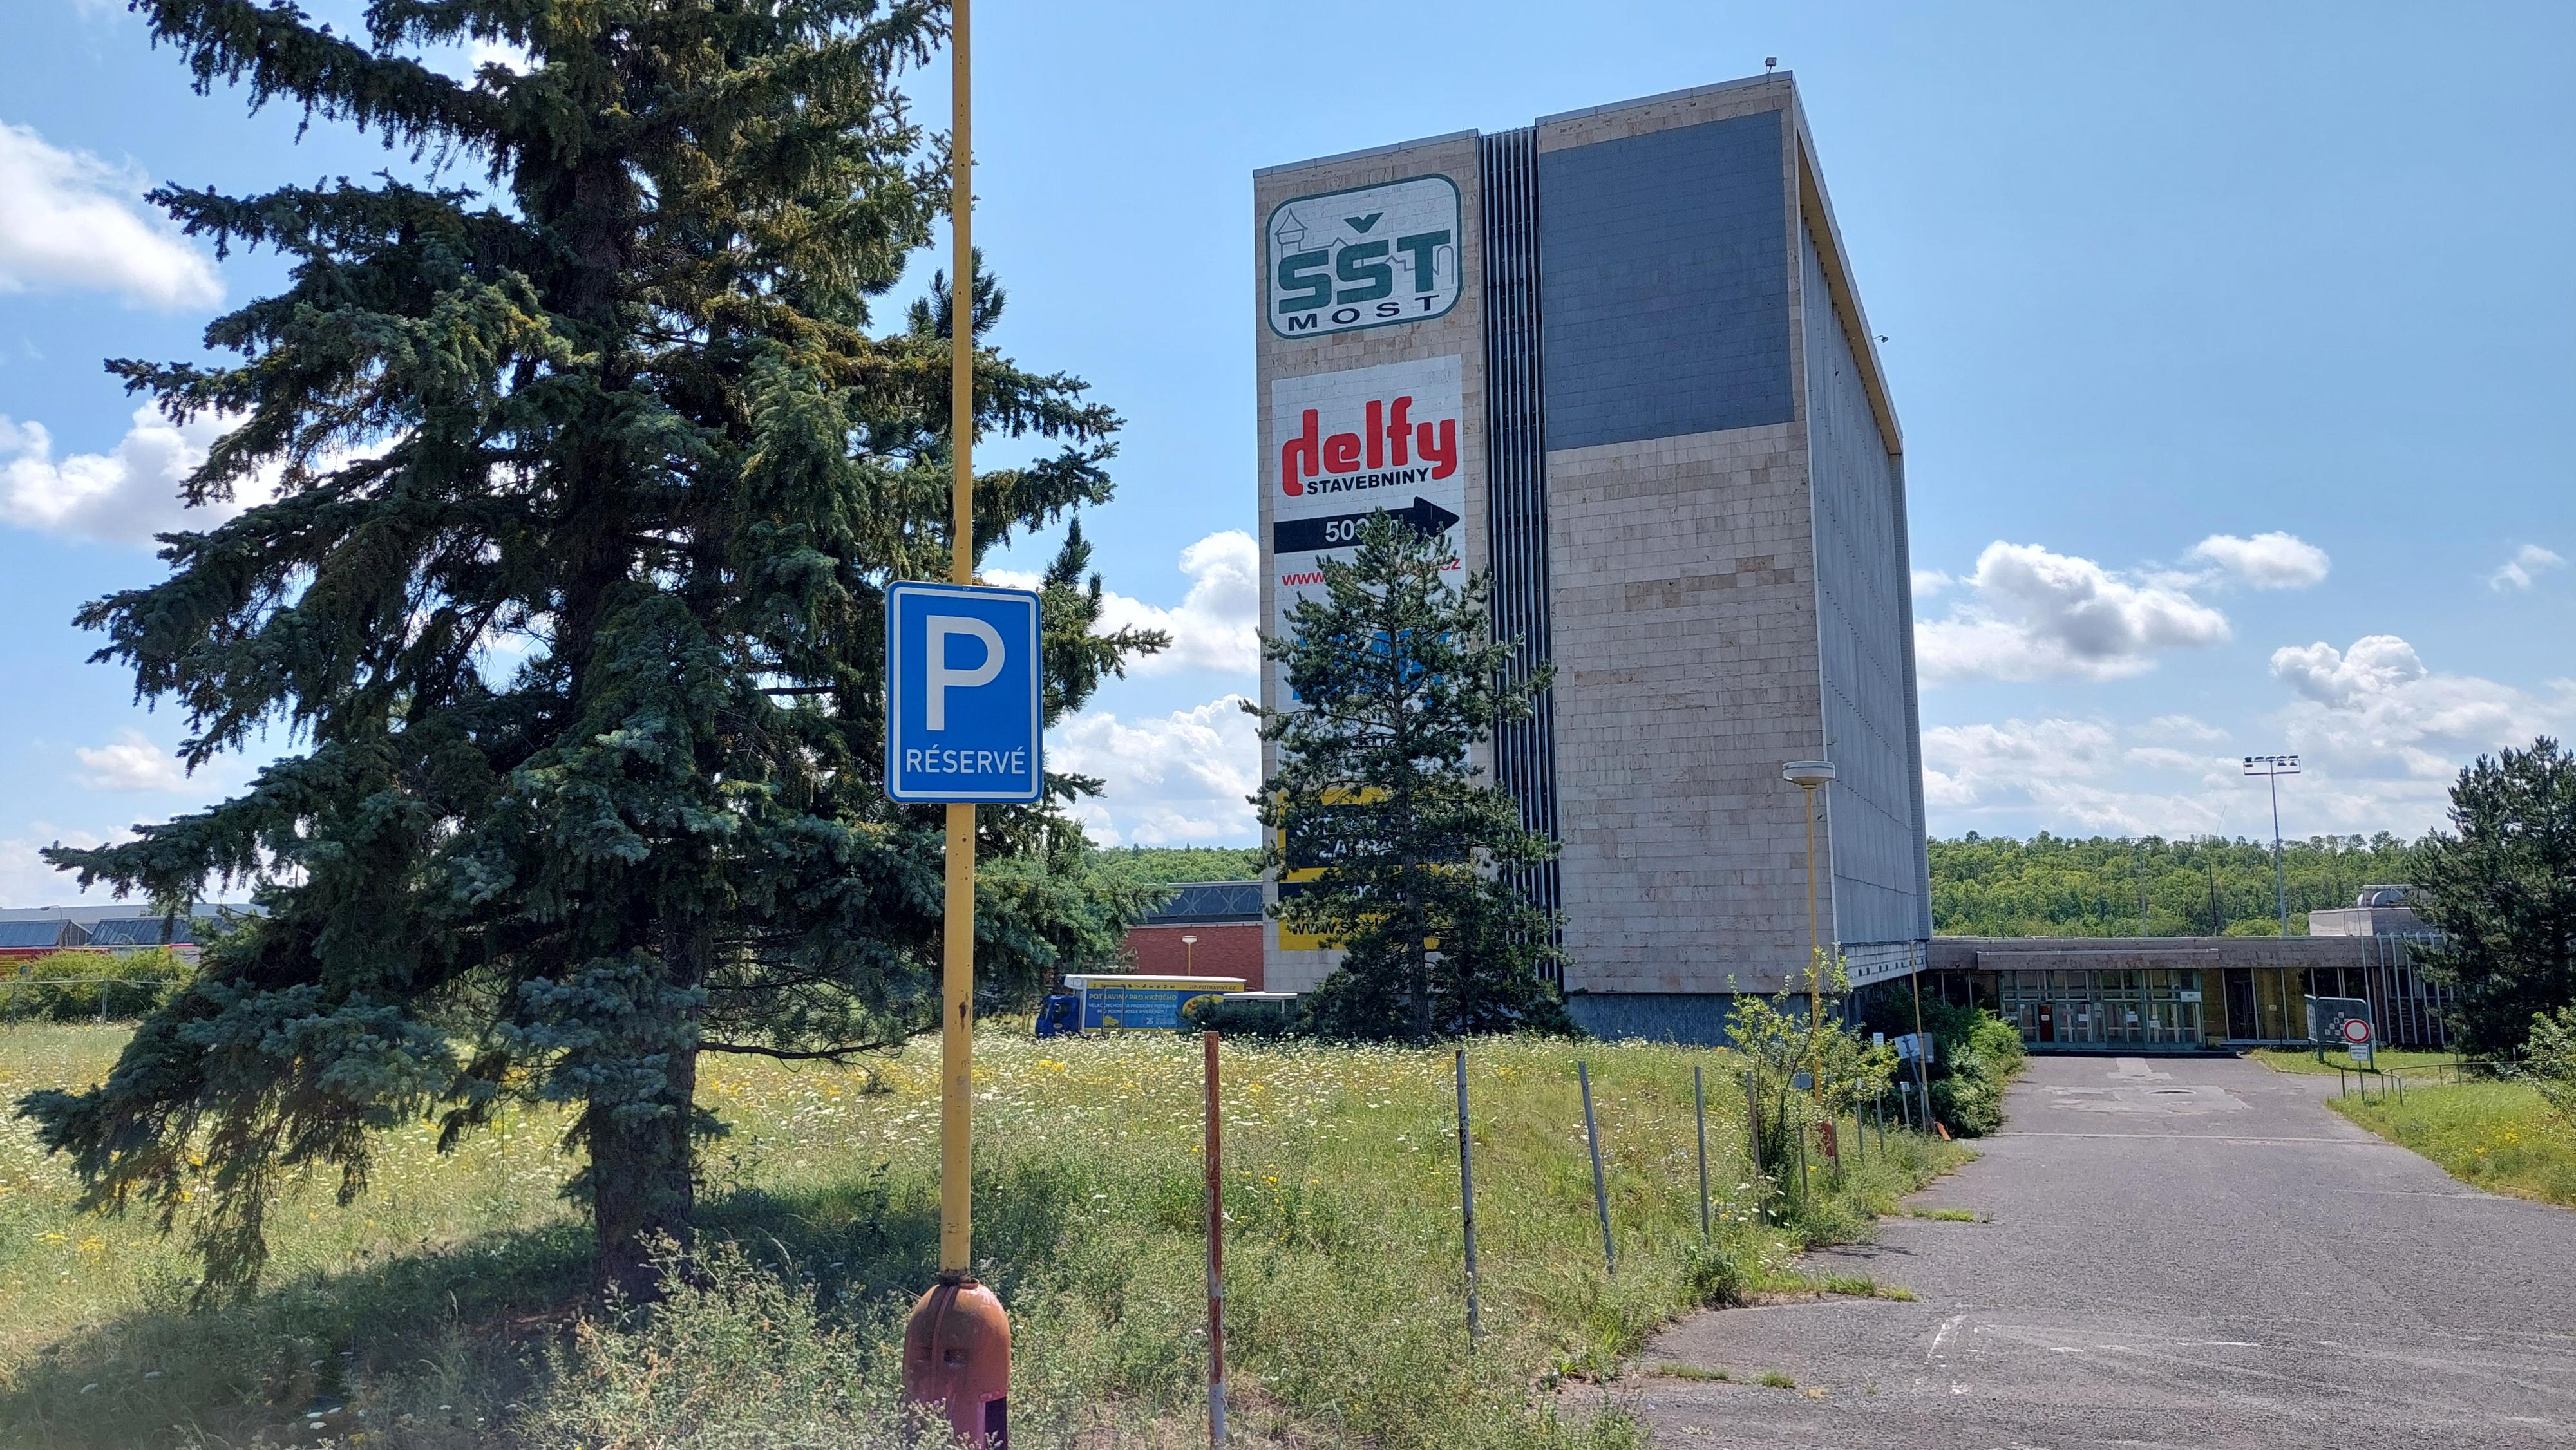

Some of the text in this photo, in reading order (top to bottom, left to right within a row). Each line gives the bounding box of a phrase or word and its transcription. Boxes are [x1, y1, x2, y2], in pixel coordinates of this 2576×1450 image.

[1278, 212, 1450, 314] SŠT
[1288, 295, 1439, 331] MOST
[1282, 396, 1457, 496] delfy
[1307, 467, 1429, 495] STAVEBNINY
[926, 614, 1006, 731] P
[906, 744, 1025, 774] RÉSERVÉ
